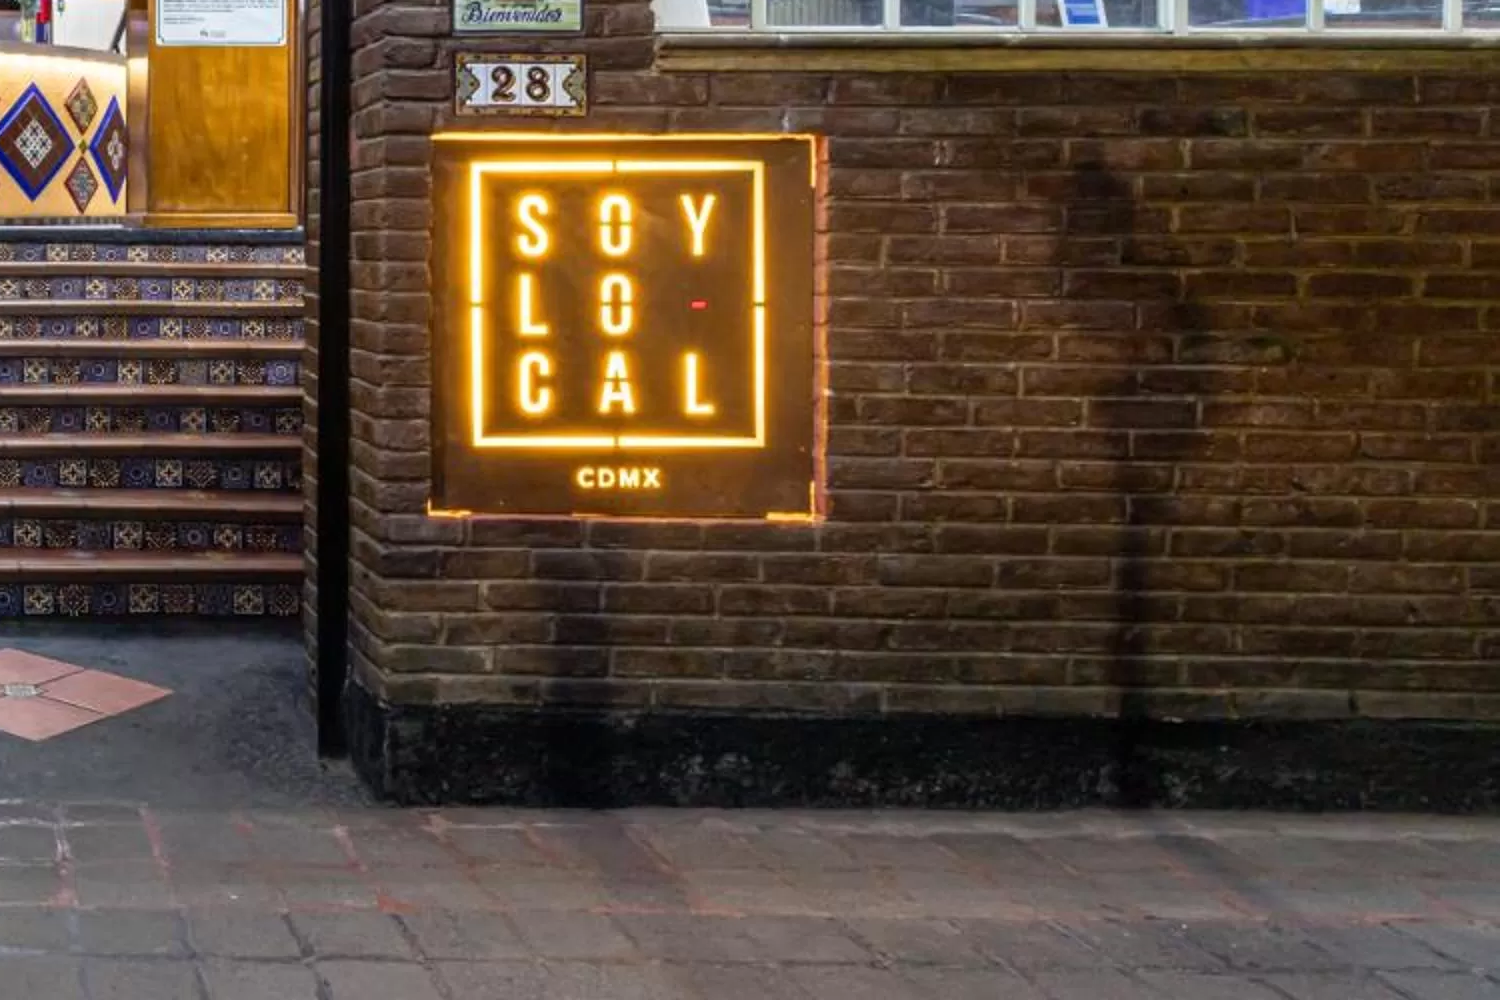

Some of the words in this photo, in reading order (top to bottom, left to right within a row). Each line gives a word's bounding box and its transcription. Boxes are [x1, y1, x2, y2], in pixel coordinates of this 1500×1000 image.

[490, 65, 549, 102] 28
[516, 194, 717, 257] SOY
[517, 351, 716, 414] CAL
[576, 466, 662, 489] CDMX
